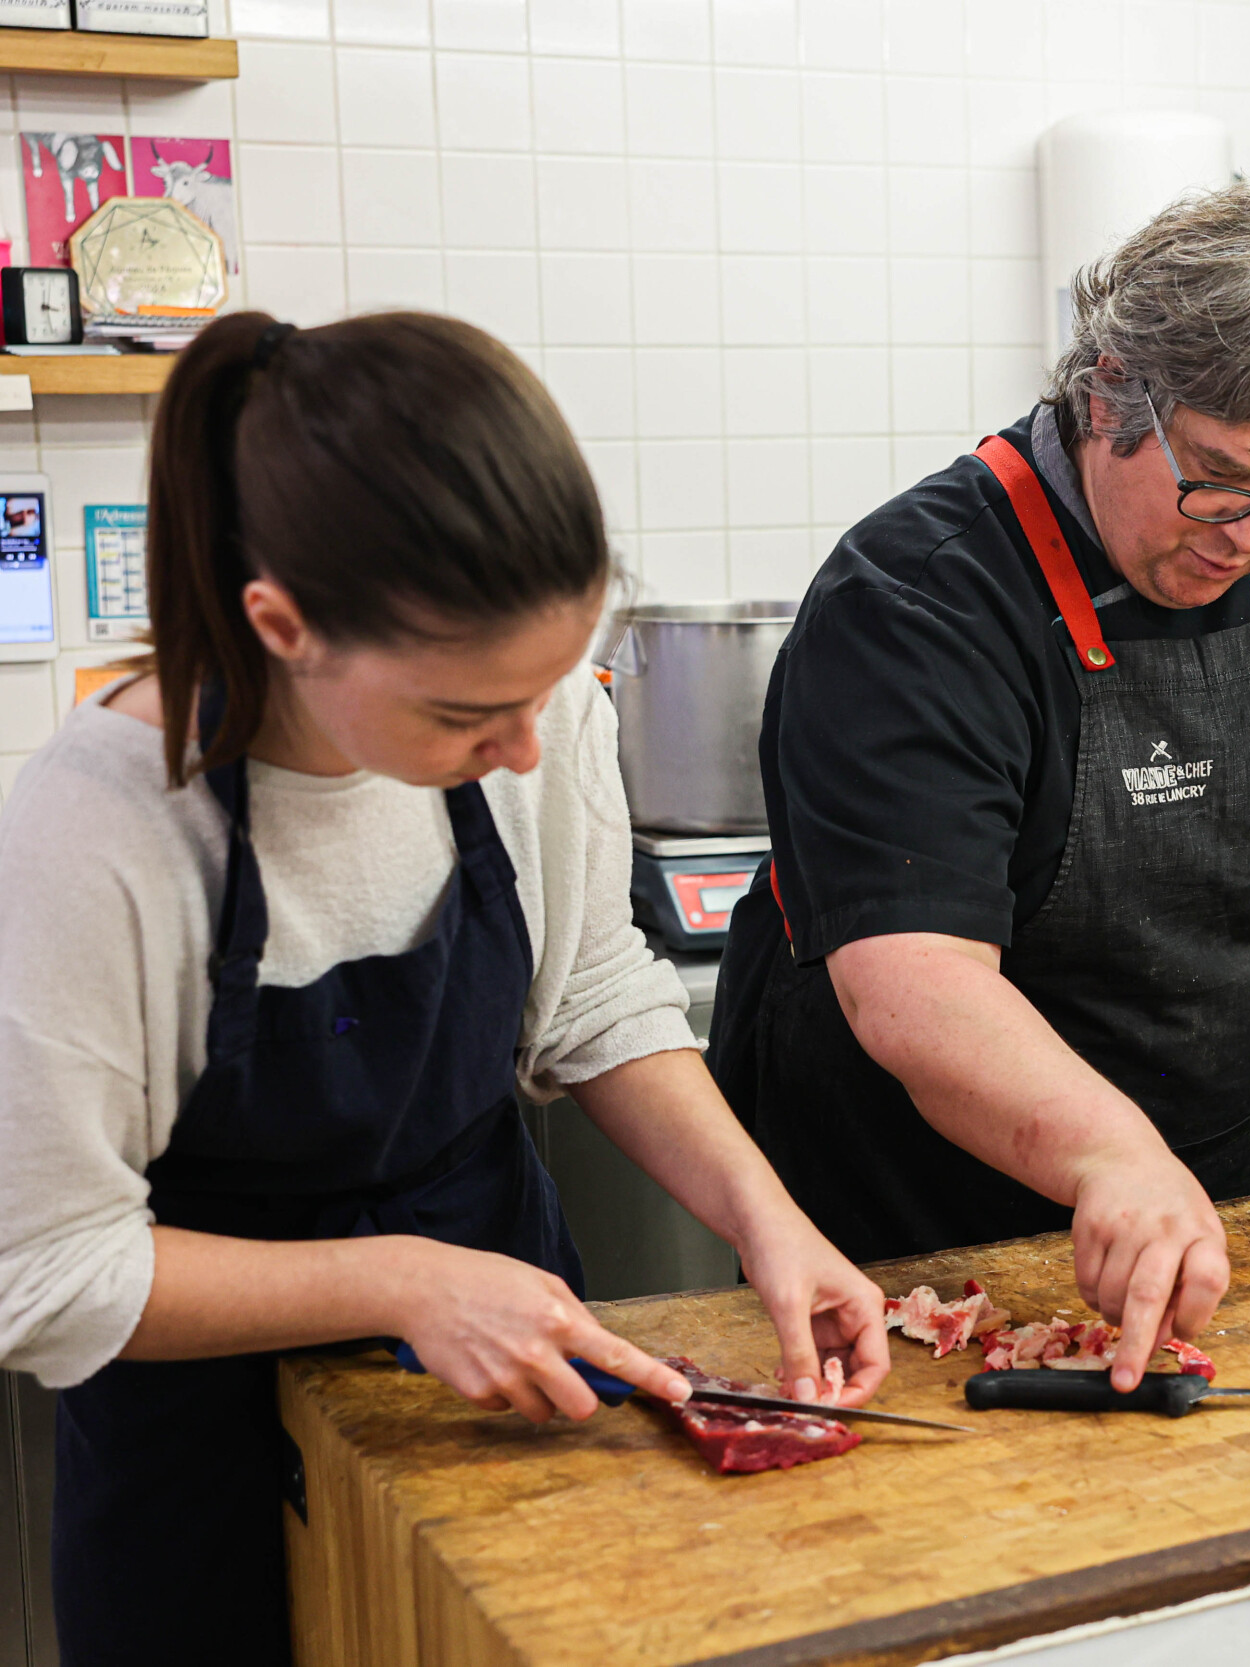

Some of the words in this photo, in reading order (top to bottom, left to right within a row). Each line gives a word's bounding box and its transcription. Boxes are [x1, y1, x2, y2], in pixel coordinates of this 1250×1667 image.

[1122, 764, 1178, 791] VIANDE
[1185, 759, 1214, 779] CHEF
[1131, 792, 1145, 806] 38
[1166, 784, 1206, 802] LANCRY
